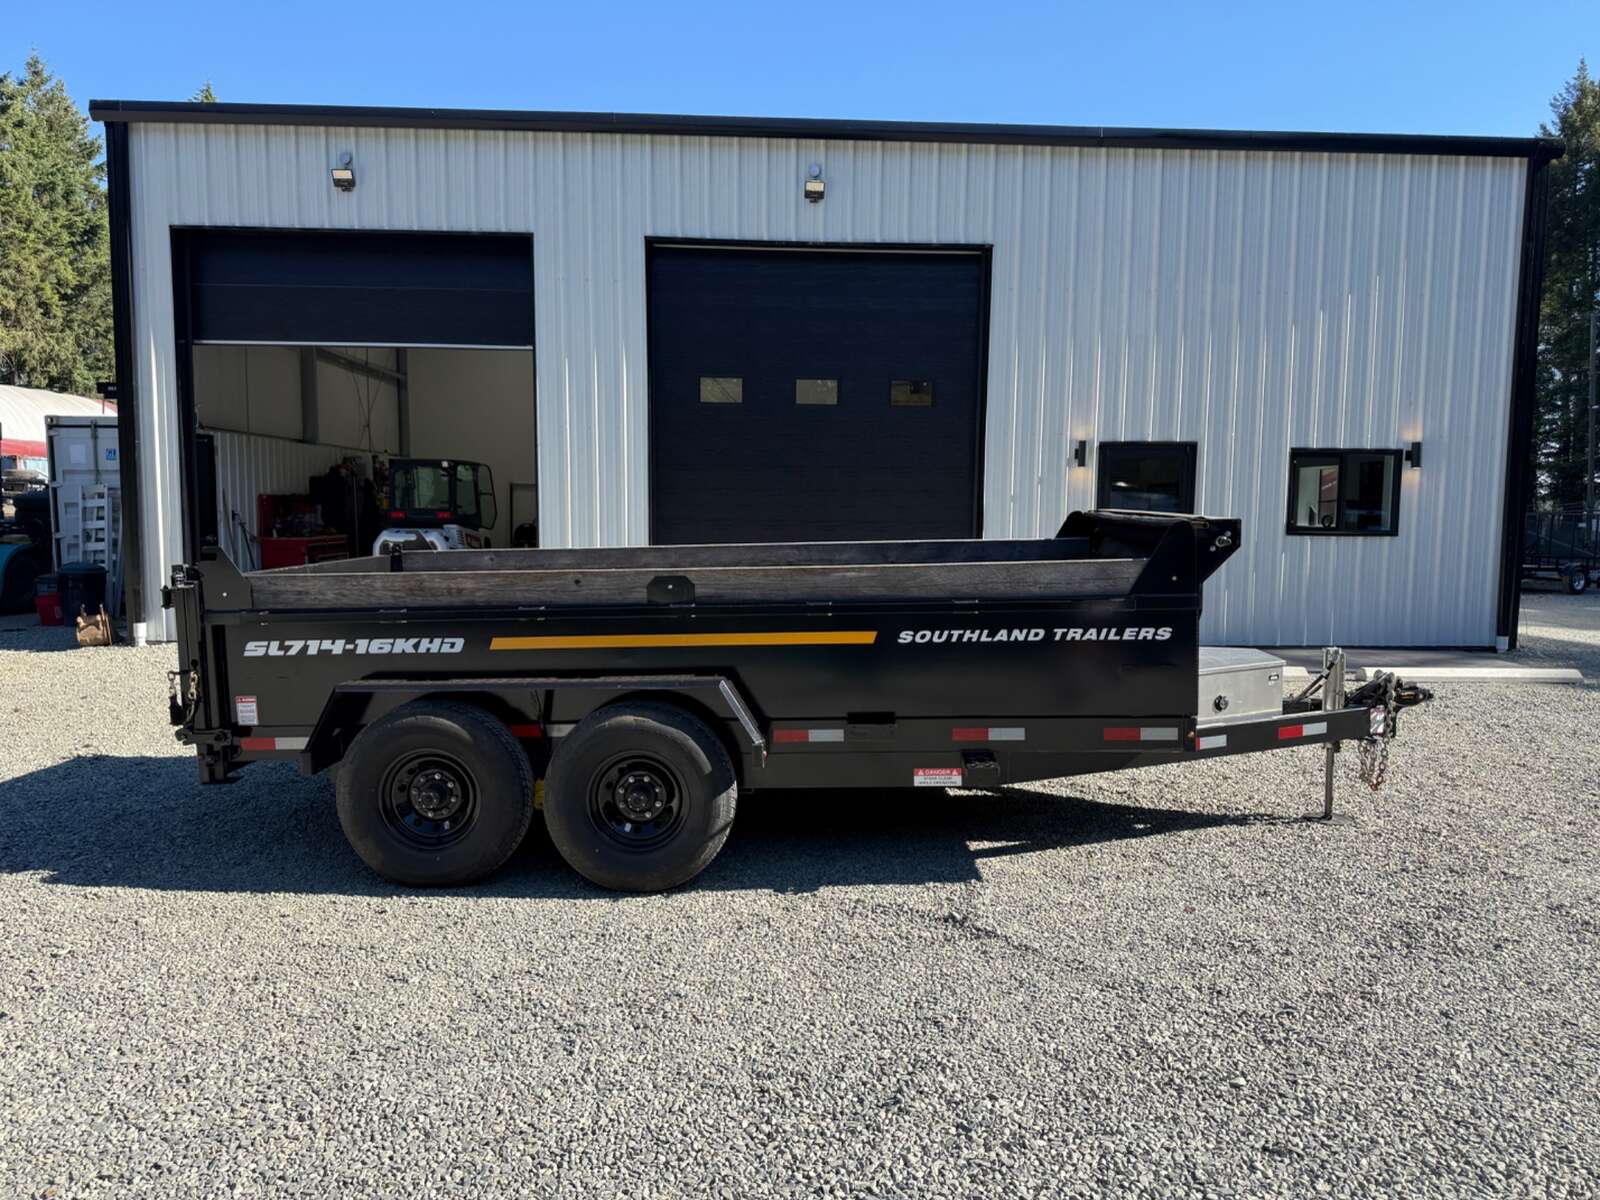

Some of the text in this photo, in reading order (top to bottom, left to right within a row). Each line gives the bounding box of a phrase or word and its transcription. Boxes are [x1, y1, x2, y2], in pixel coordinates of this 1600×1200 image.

[897, 627, 1173, 643] SOUTHLAND TRAILERS
[243, 638, 465, 657] SL714-16KHD
